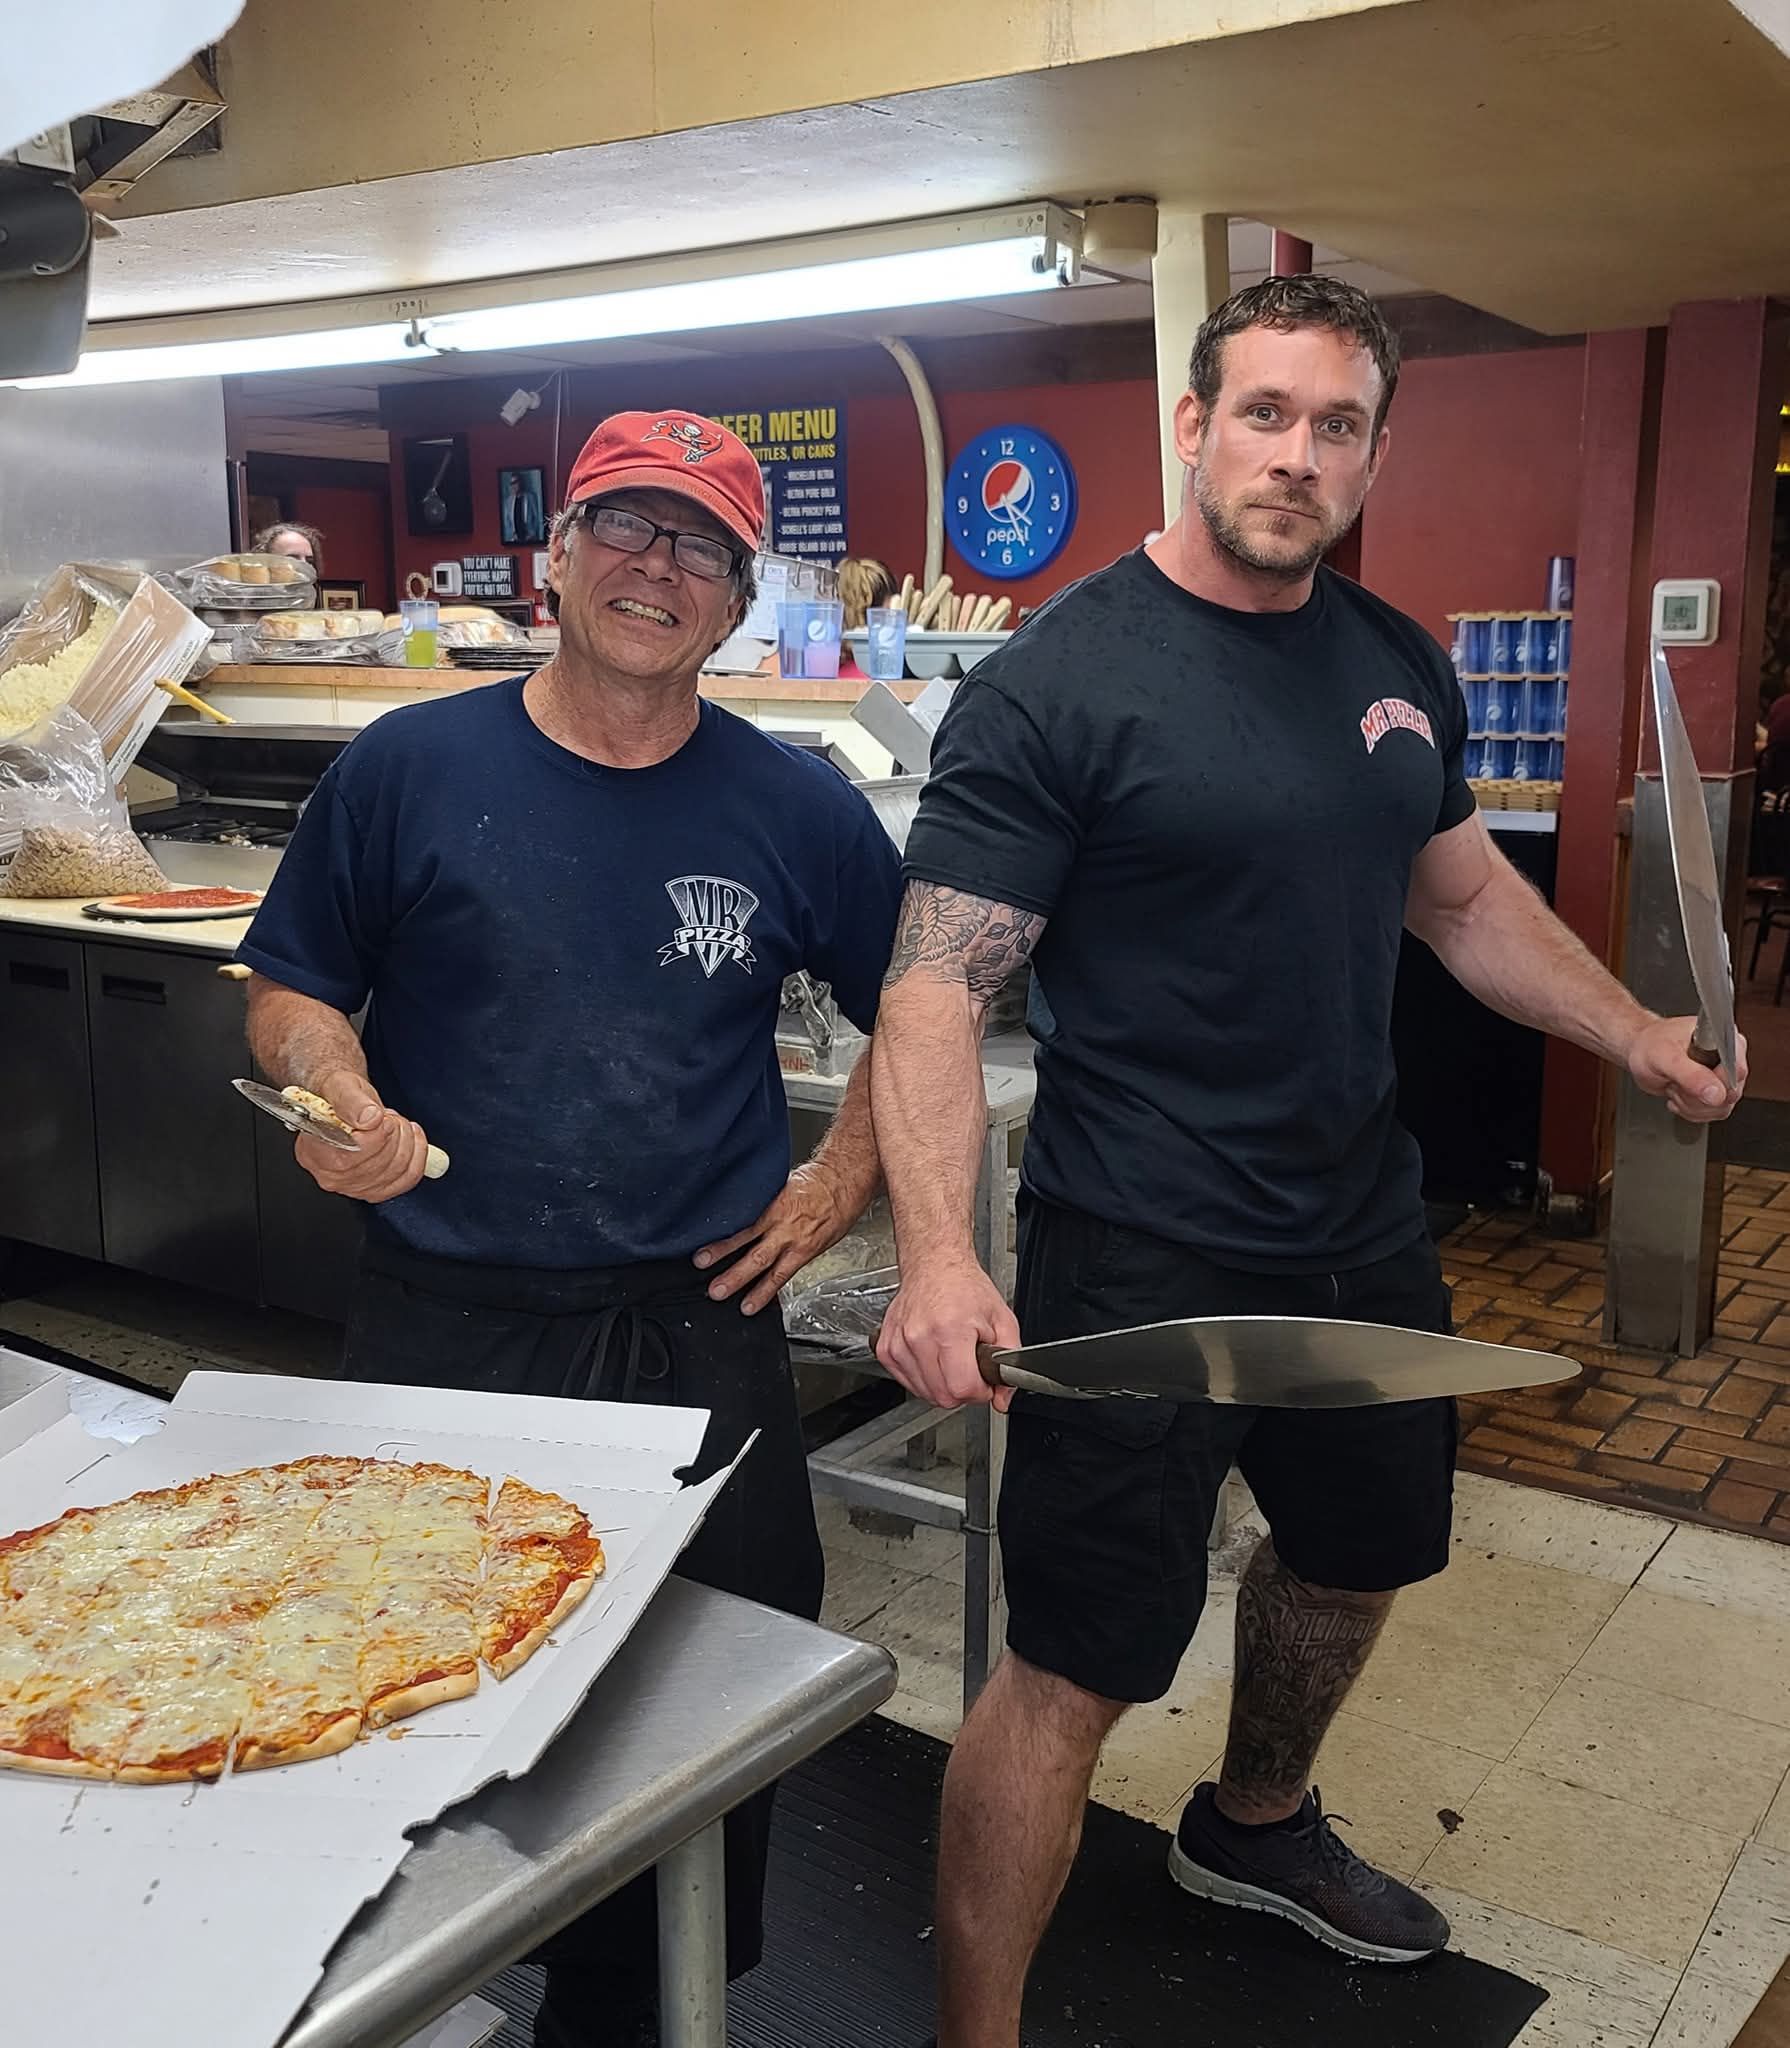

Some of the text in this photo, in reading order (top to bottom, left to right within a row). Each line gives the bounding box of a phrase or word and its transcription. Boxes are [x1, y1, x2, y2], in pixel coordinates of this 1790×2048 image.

[709, 408, 836, 443] EER MENU
[792, 446, 806, 460] OR
[807, 444, 836, 459] CANS
[1000, 440, 1014, 456] 12
[957, 497, 968, 514] 9
[1050, 495, 1061, 511] 3
[463, 557, 511, 570] YOU CAN'T MAKE
[1001, 548, 1012, 565] 6
[491, 570, 511, 583] HAPPY
[484, 583, 496, 596] NOT
[496, 583, 513, 596] PIZZA
[1360, 698, 1436, 755] MR PIZZA
[684, 879, 741, 931] MR
[678, 927, 746, 952] PIZZA
